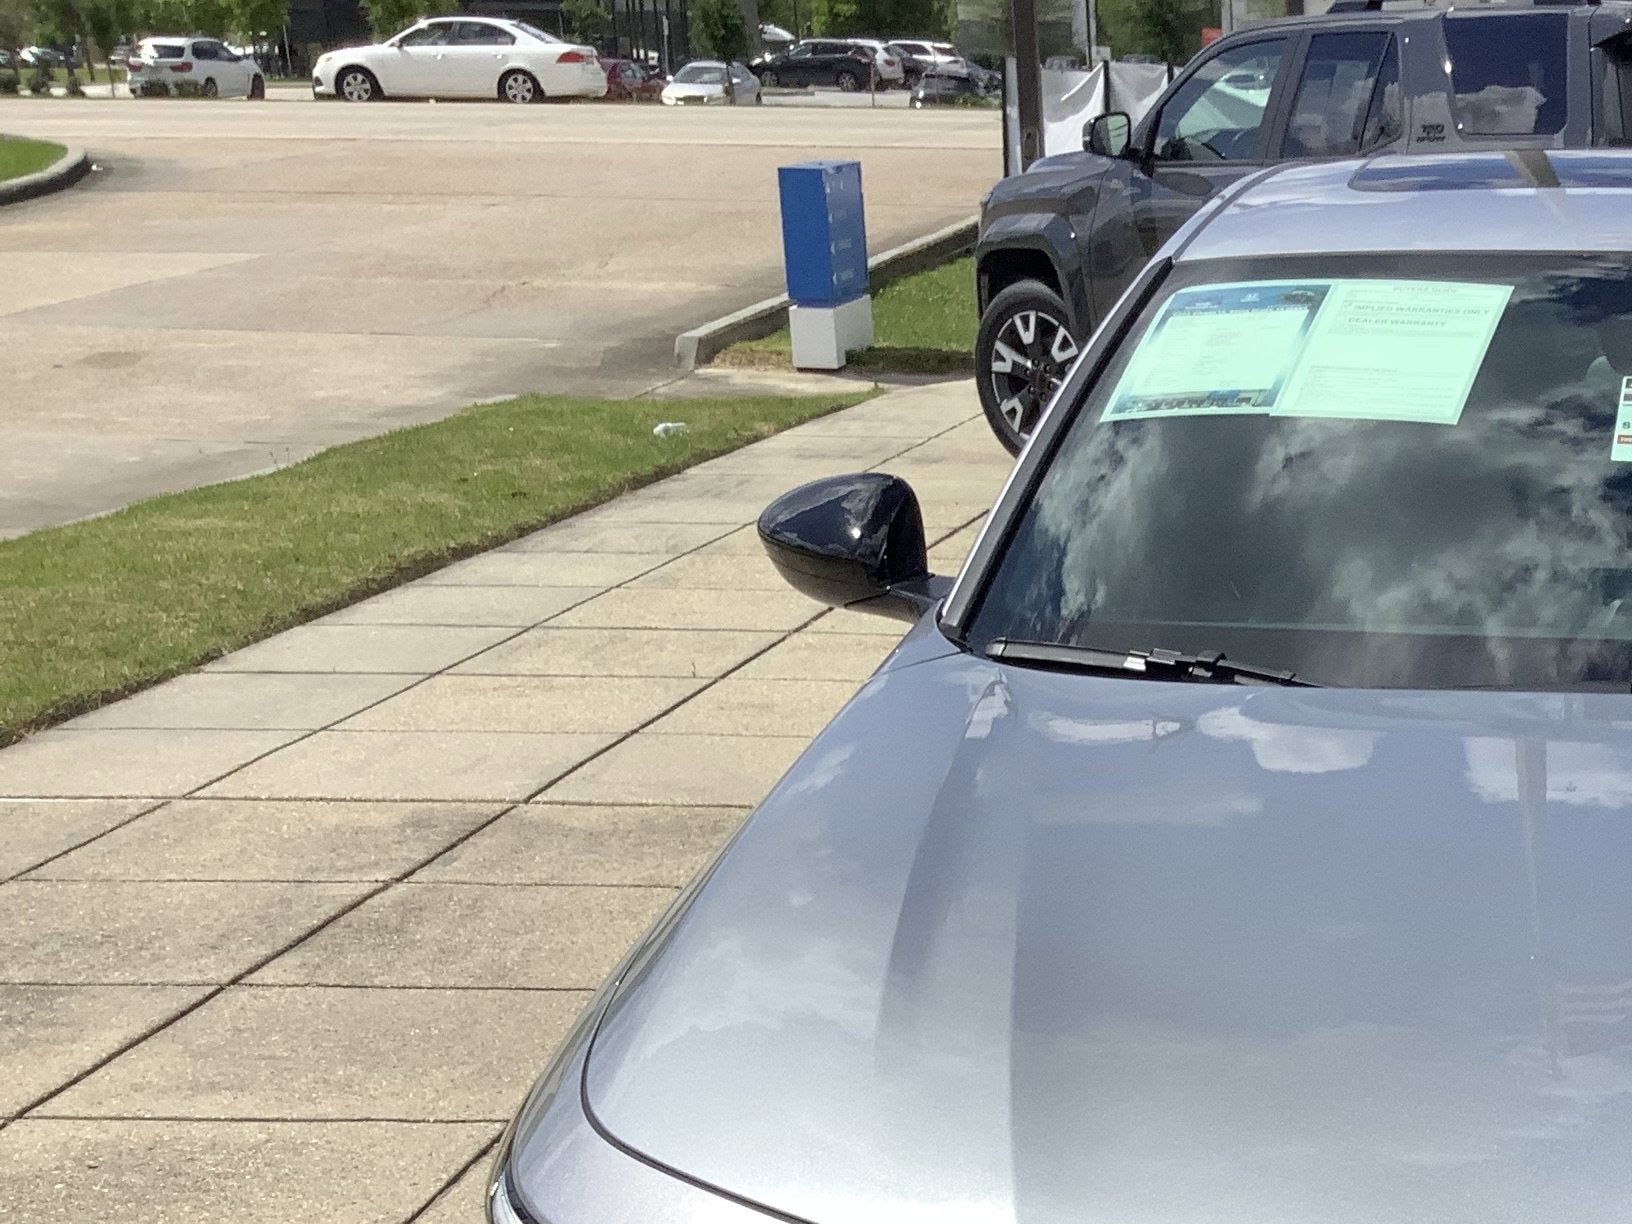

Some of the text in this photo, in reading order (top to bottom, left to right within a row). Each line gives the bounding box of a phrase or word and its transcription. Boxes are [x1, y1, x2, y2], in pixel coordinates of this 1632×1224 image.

[1353, 304, 1393, 312] IMPLIED
[1347, 317, 1447, 327] DEALER WARRANTY
